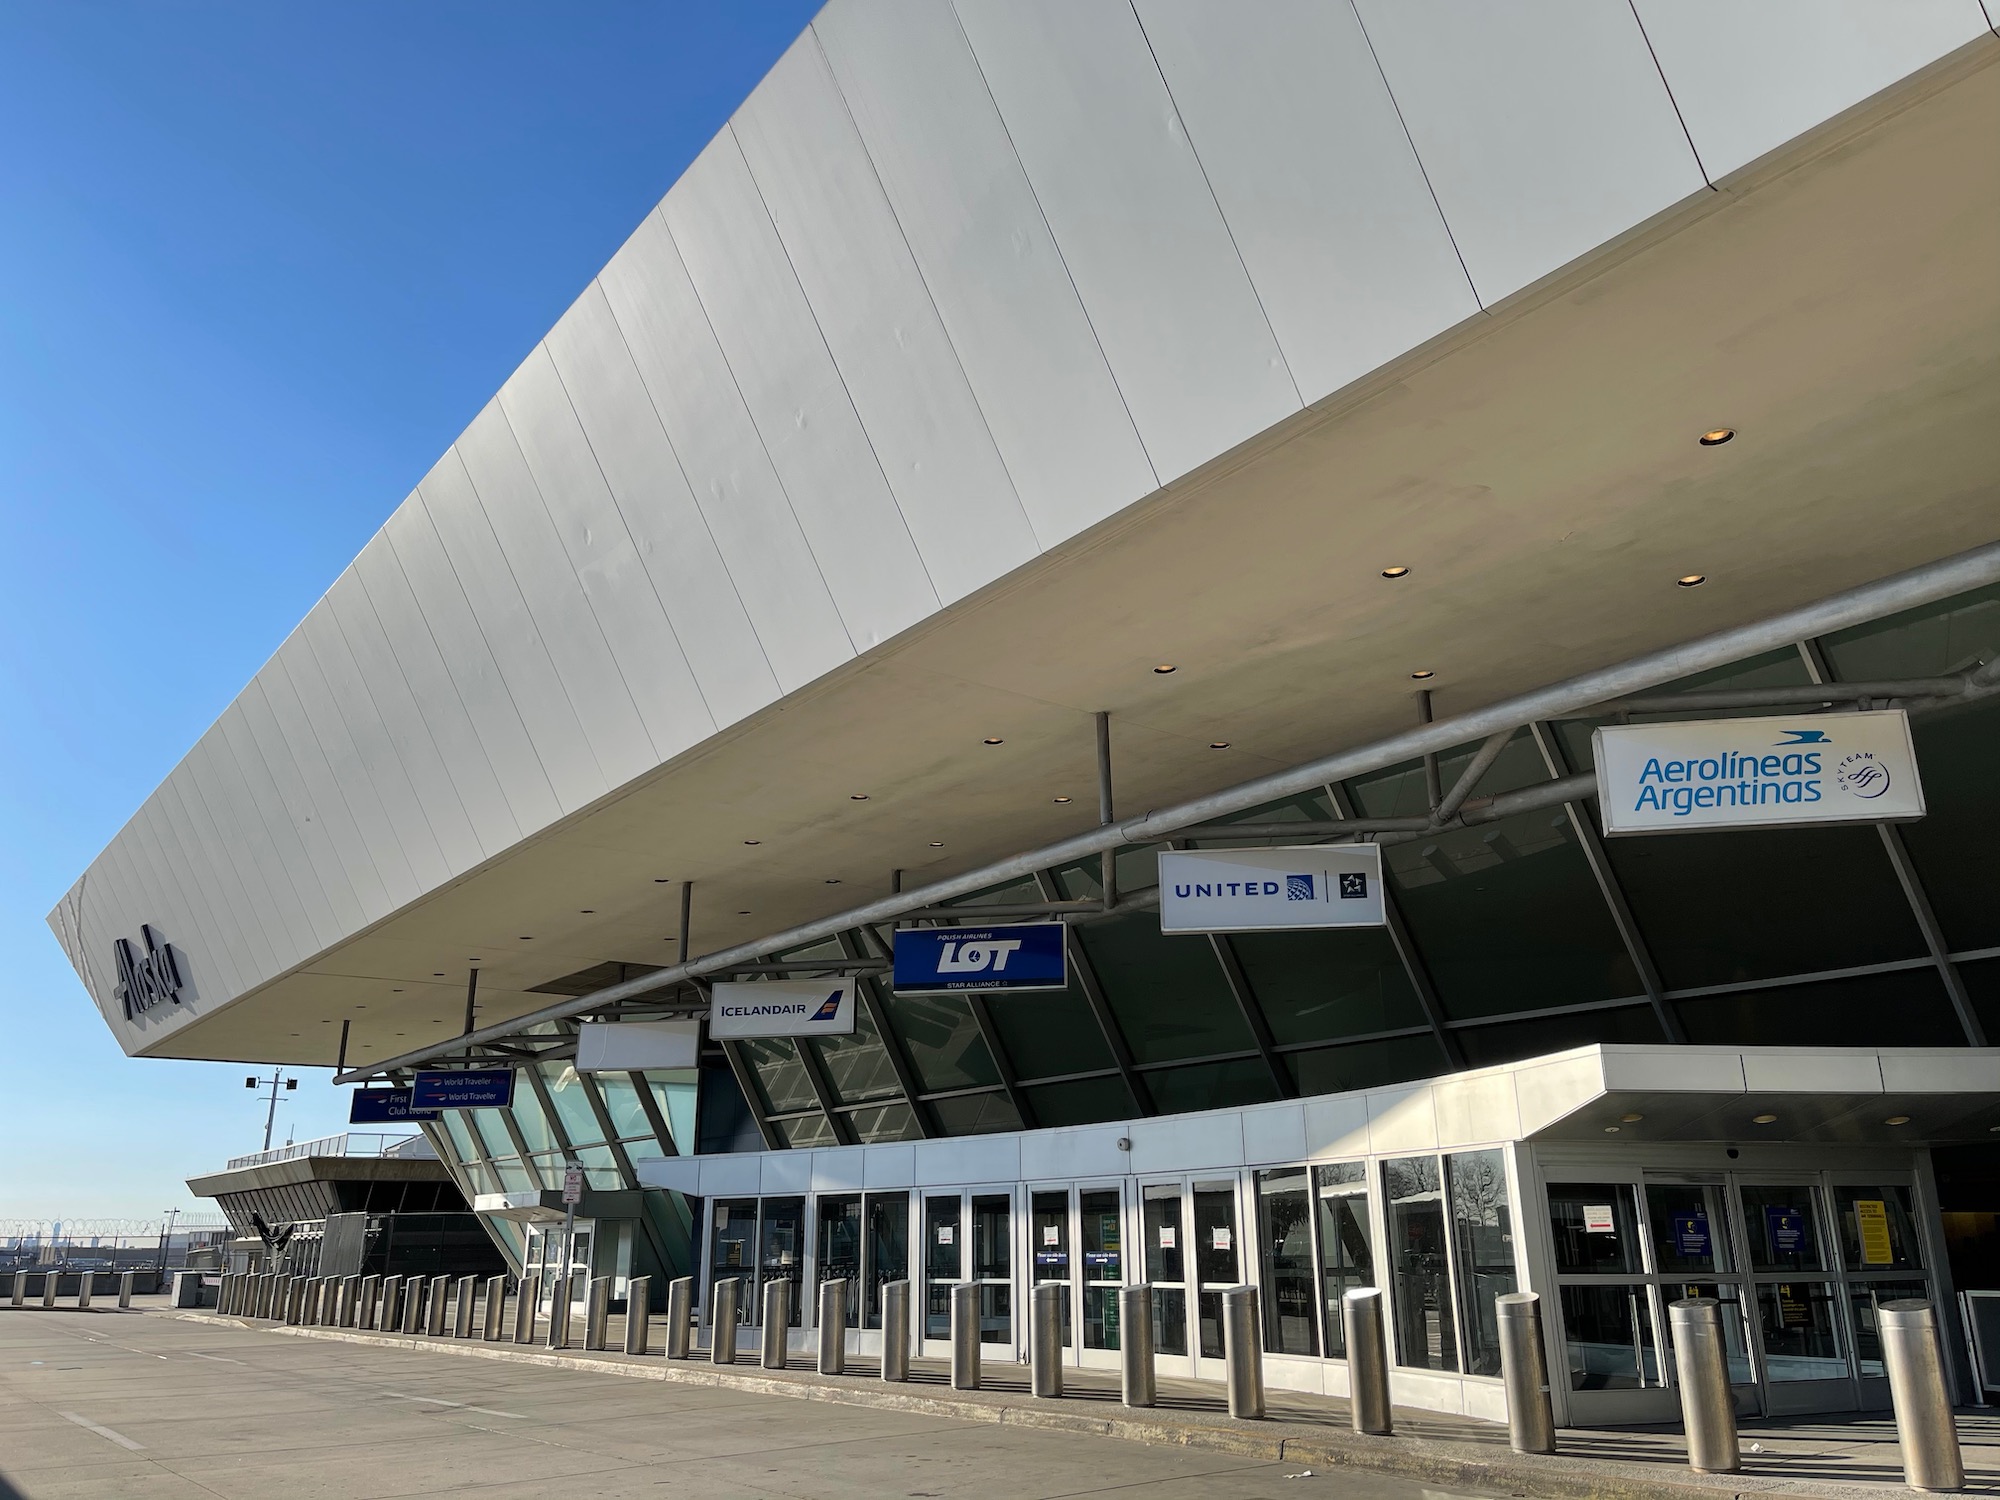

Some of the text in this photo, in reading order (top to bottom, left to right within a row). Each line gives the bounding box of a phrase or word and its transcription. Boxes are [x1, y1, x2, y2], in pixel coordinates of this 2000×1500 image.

[1639, 751, 1821, 784] Aerolíneas
[1837, 753, 1873, 791] SKYTEAM
[1634, 780, 1821, 816] Argentinas
[1175, 881, 1280, 898] UNITED
[962, 932, 993, 940] AIRLINES
[937, 939, 1022, 974] LOT
[721, 1004, 806, 1017] ICELANDAIR
[444, 1078, 463, 1086] World
[464, 1077, 492, 1085] Traveller
[389, 1094, 407, 1103] First
[448, 1092, 497, 1101] World Traveller
[388, 1106, 407, 1115] Club
